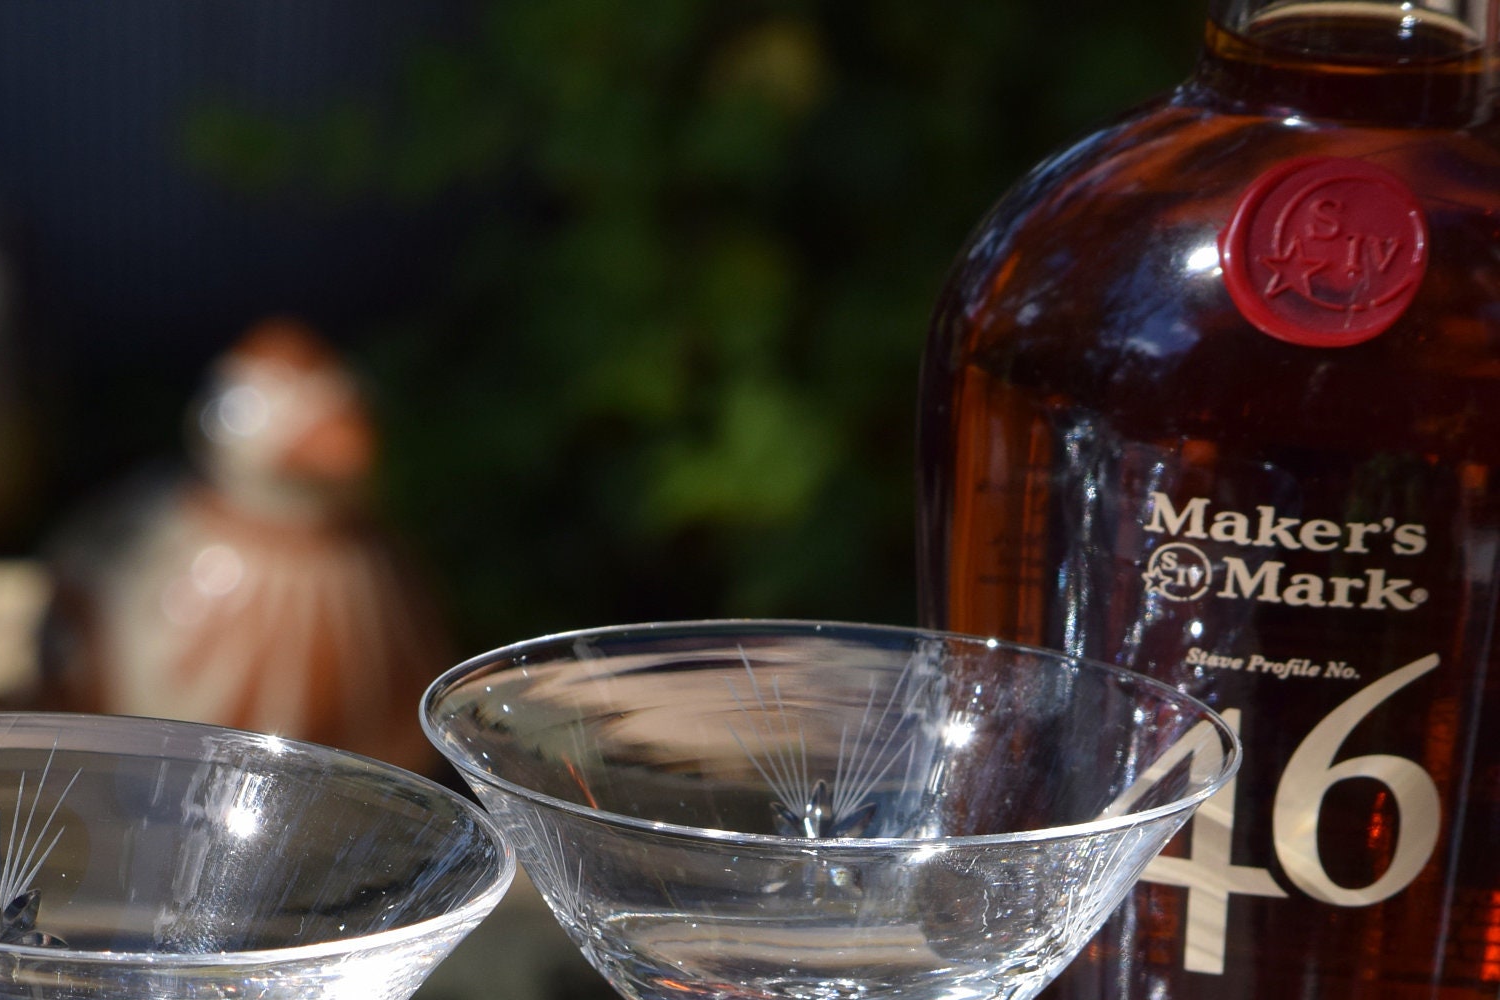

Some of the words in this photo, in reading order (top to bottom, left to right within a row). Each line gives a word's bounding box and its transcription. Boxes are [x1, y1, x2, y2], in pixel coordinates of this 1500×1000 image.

[1143, 491, 1427, 555] Maker's
[1216, 555, 1419, 611] Mark
[1186, 647, 1245, 671] Stave
[1246, 654, 1321, 680] Profile
[1324, 661, 1361, 680] No.
[1096, 652, 1442, 977] 46
